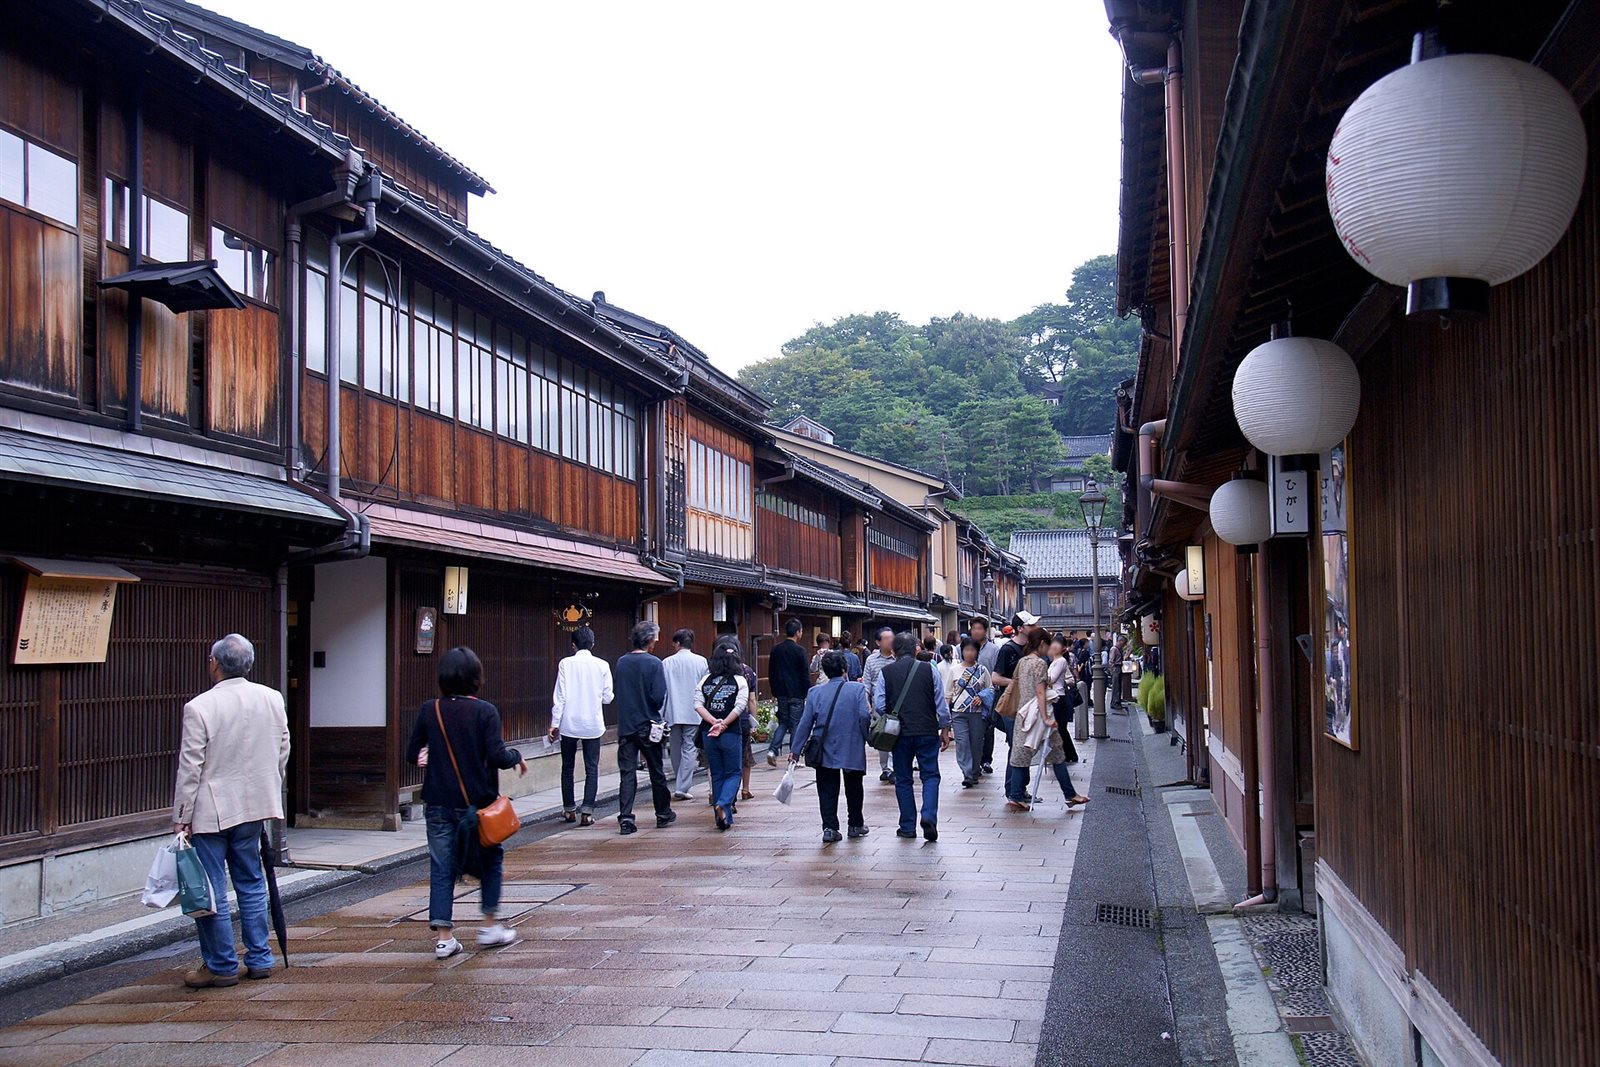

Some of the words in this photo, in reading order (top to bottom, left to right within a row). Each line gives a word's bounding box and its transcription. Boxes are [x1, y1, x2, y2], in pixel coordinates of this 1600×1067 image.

[1285, 478, 1298, 524] ひがし
[447, 588, 455, 609] ひがし
